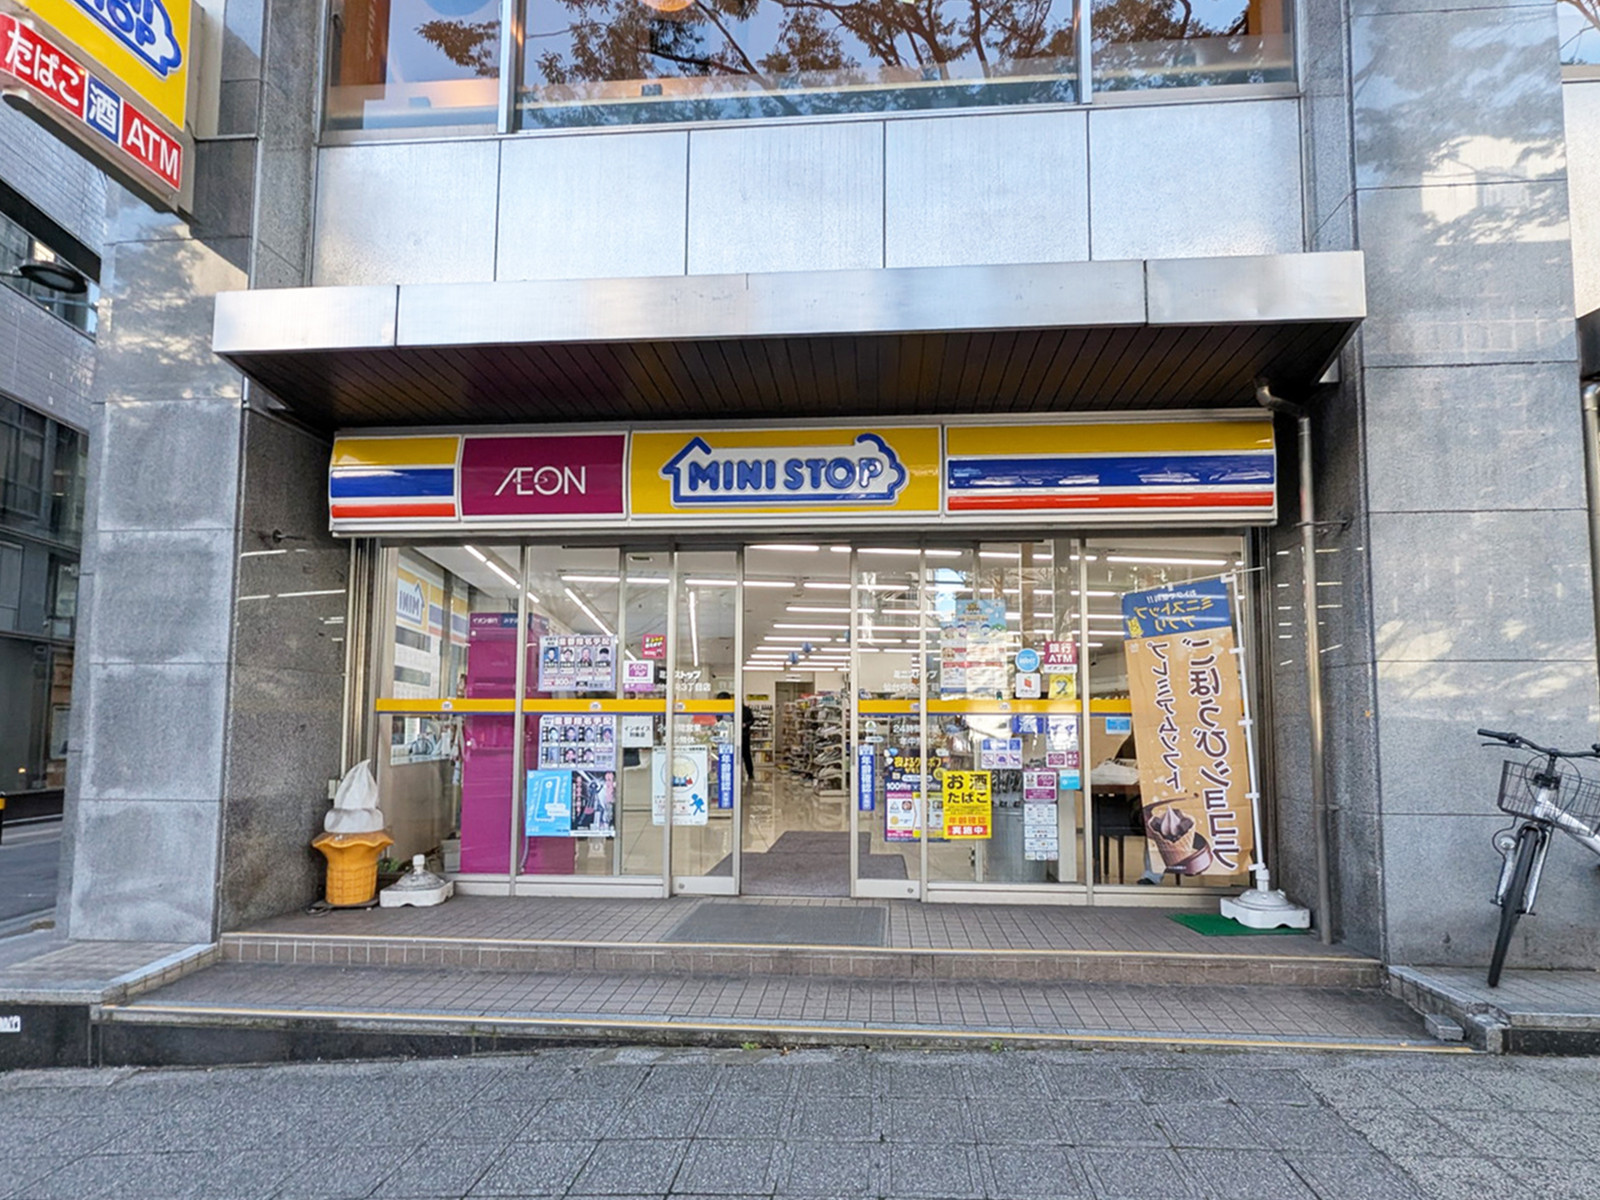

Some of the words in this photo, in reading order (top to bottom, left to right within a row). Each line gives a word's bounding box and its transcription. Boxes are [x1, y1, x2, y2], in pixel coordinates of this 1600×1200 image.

[5, 29, 80, 107] たばこ
[89, 81, 117, 136] 酒
[126, 117, 179, 181] ATM
[687, 458, 776, 493] MINI
[782, 456, 884, 491] STOP
[1049, 643, 1072, 653] 銀行
[1048, 654, 1073, 663] ATM
[947, 774, 988, 790] お酒
[948, 792, 988, 804] たばこ
